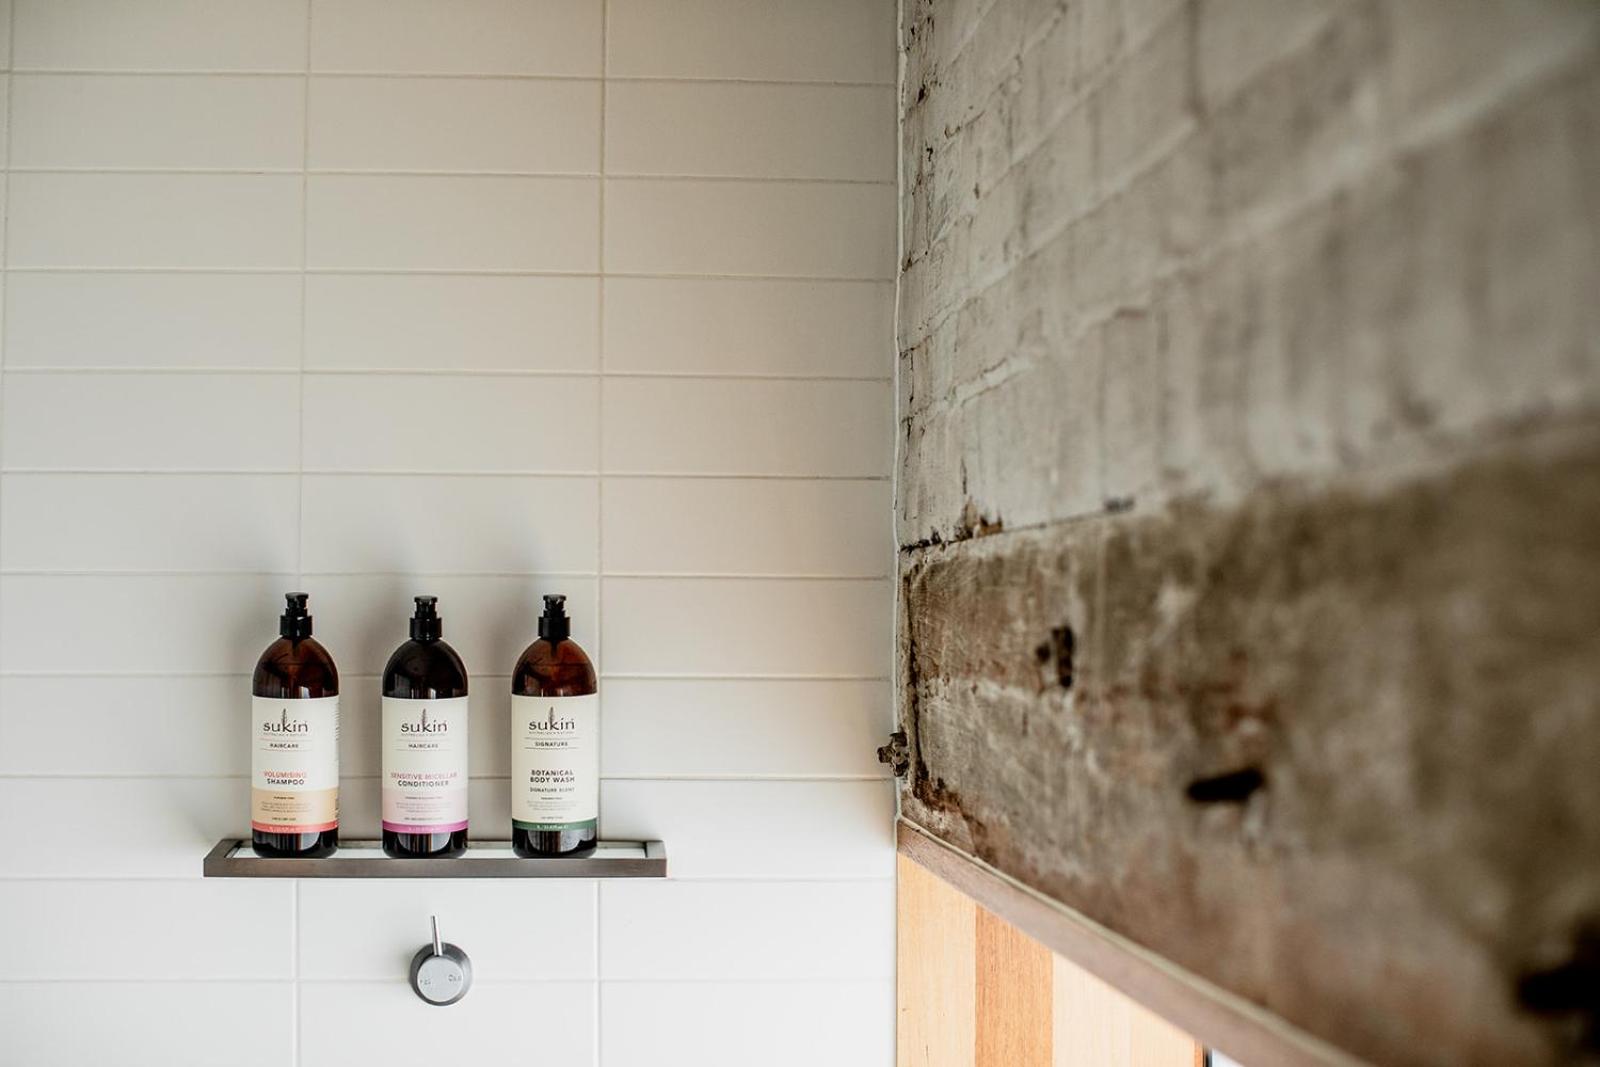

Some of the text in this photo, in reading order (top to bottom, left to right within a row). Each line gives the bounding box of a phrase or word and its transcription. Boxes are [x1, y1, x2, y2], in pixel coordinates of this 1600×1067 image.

[263, 709, 308, 732] sukin
[400, 709, 447, 732] sukin
[528, 707, 575, 730] sukin
